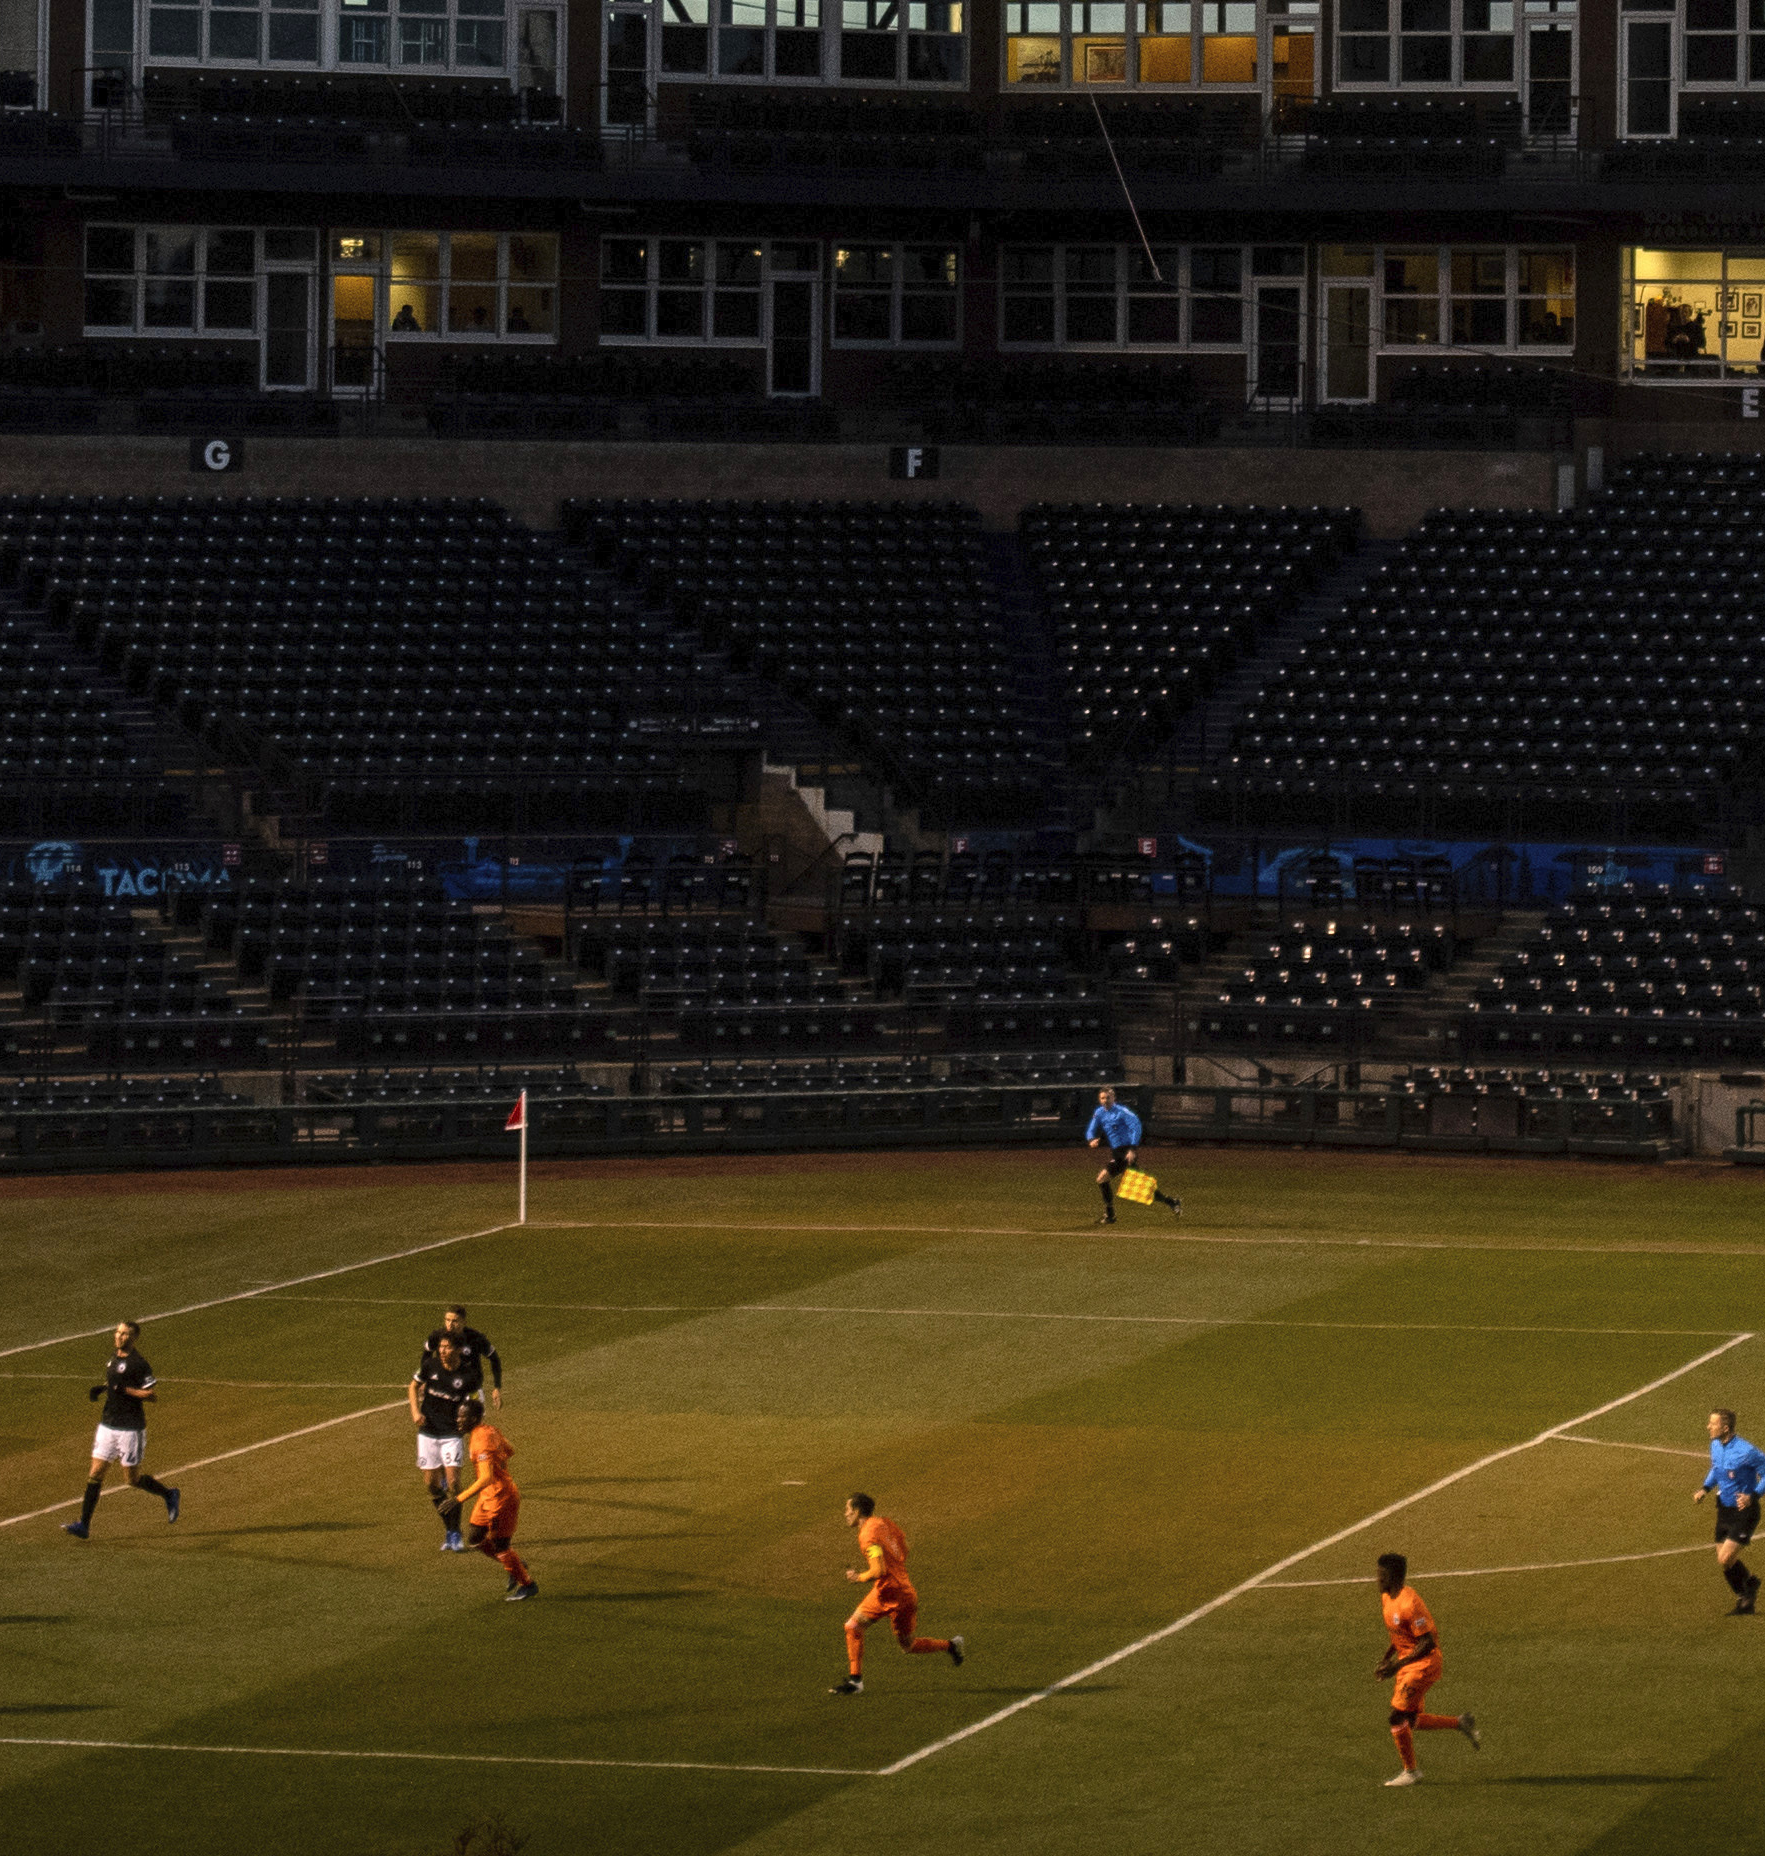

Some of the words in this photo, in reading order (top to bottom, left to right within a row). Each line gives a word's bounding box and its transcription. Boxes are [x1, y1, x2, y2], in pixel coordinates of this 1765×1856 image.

[1741, 388, 1759, 418] E
[202, 439, 230, 471] G
[907, 447, 923, 478] F
